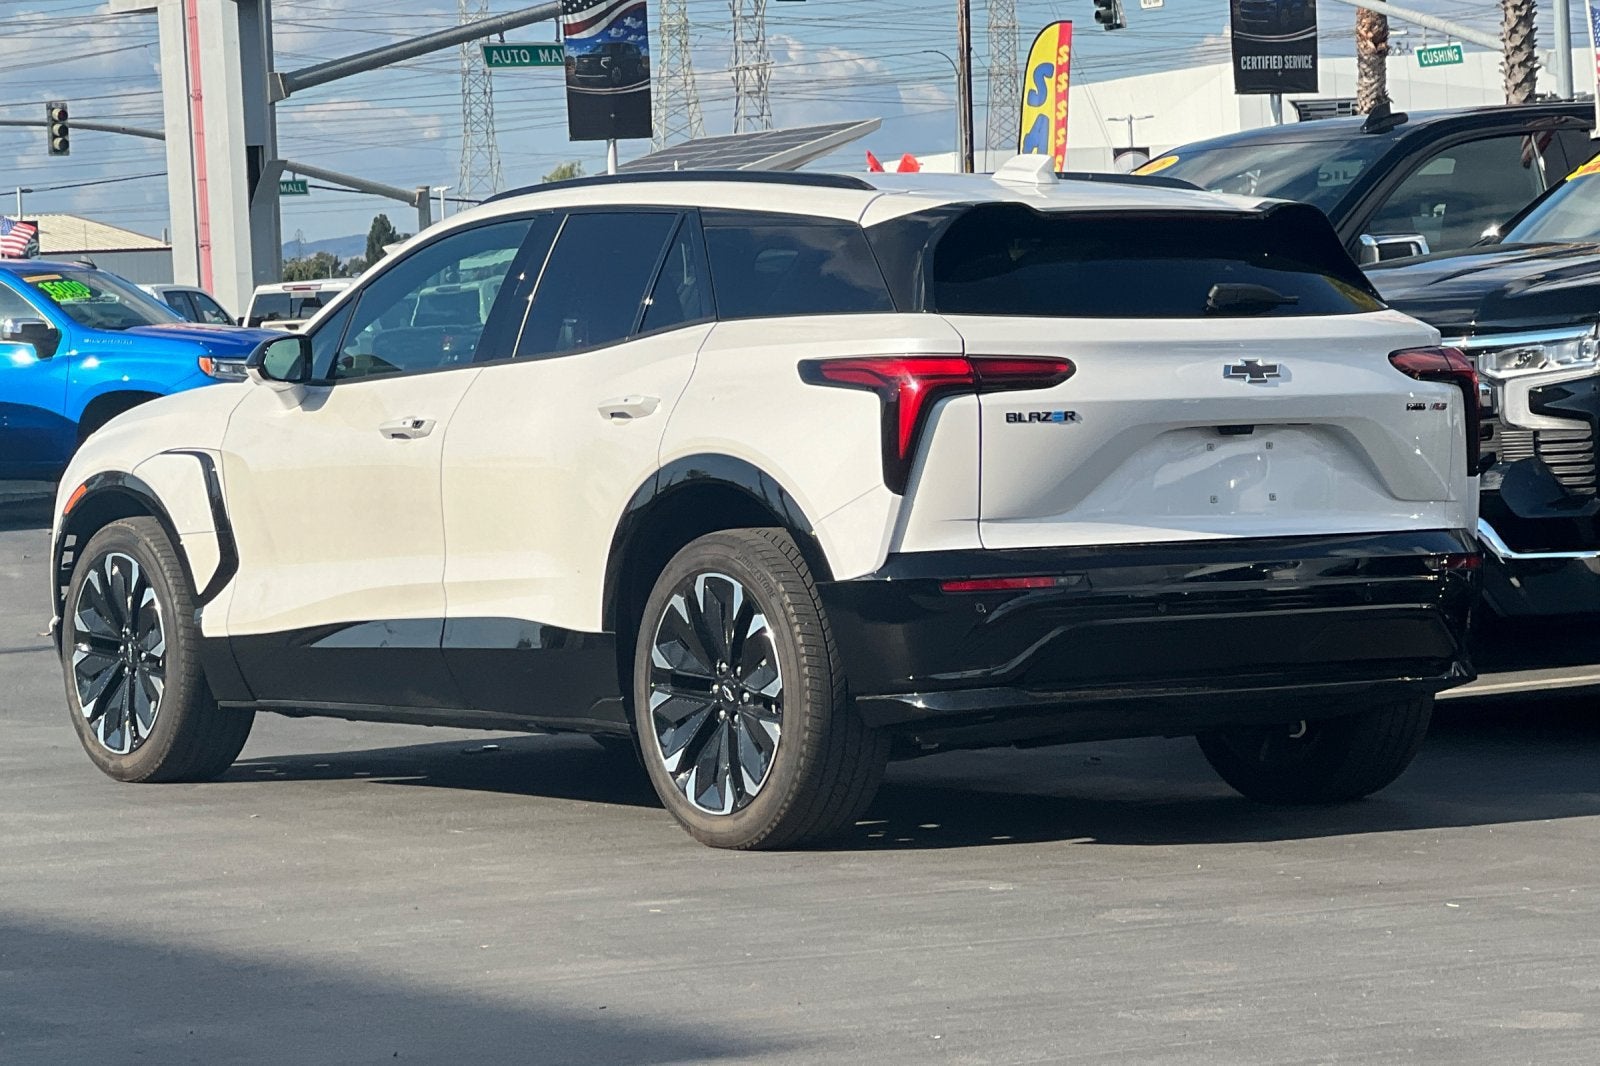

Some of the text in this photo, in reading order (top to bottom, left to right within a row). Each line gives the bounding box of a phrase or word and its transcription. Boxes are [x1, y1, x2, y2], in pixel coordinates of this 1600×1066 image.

[492, 48, 565, 64] AUTO MA
[1241, 55, 1313, 70] CERTIFIED SERVICE
[1421, 47, 1460, 65] CUSHING
[280, 182, 305, 193] MALL
[1005, 410, 1076, 424] BLAZER
